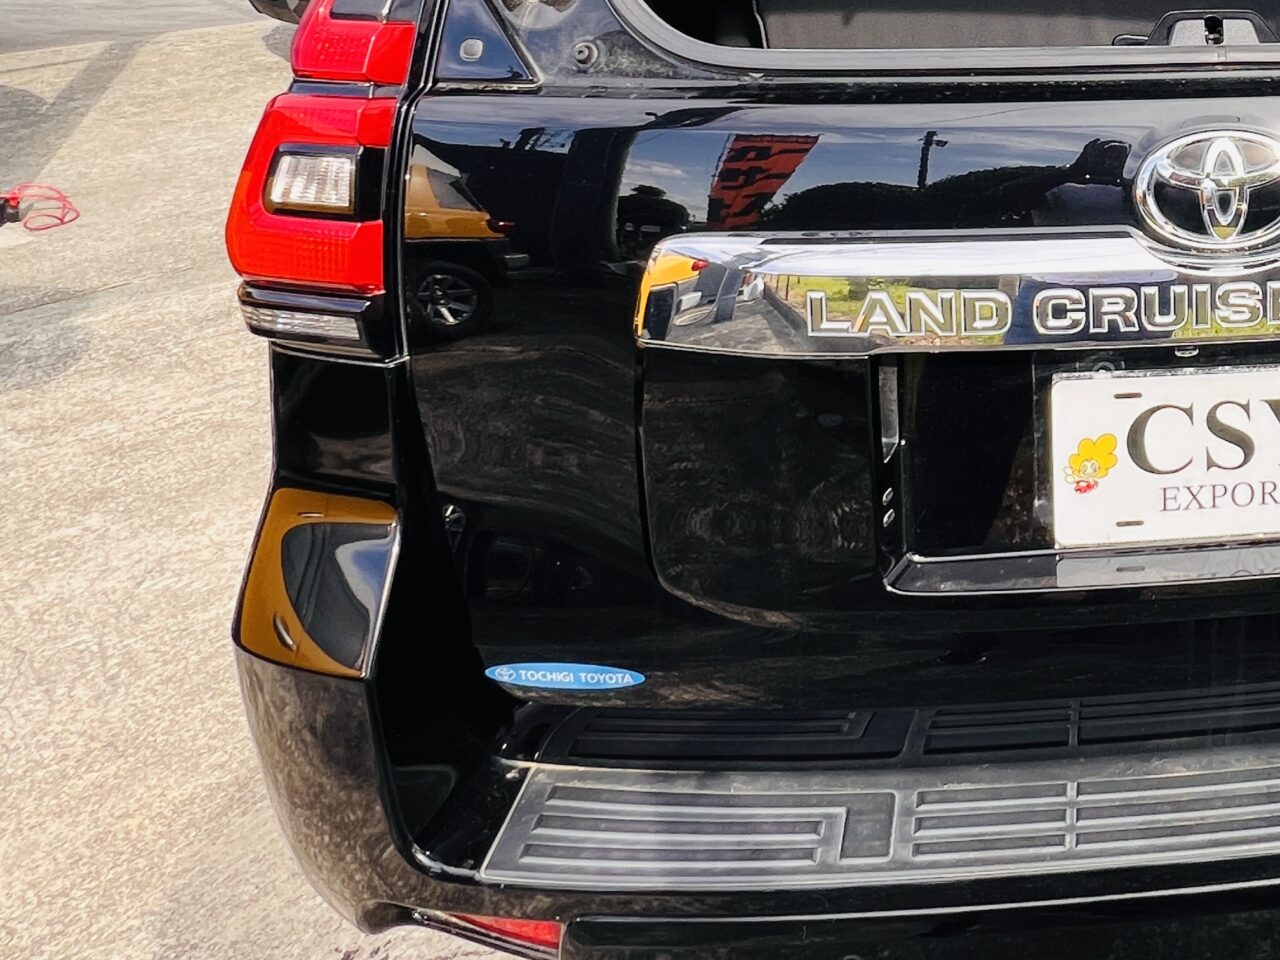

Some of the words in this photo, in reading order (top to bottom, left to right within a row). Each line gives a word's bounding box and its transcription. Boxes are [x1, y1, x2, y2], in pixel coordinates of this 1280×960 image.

[806, 289, 1013, 337] LAND
[518, 669, 574, 683] TOCHIGI
[579, 672, 635, 684] TOYOTA
